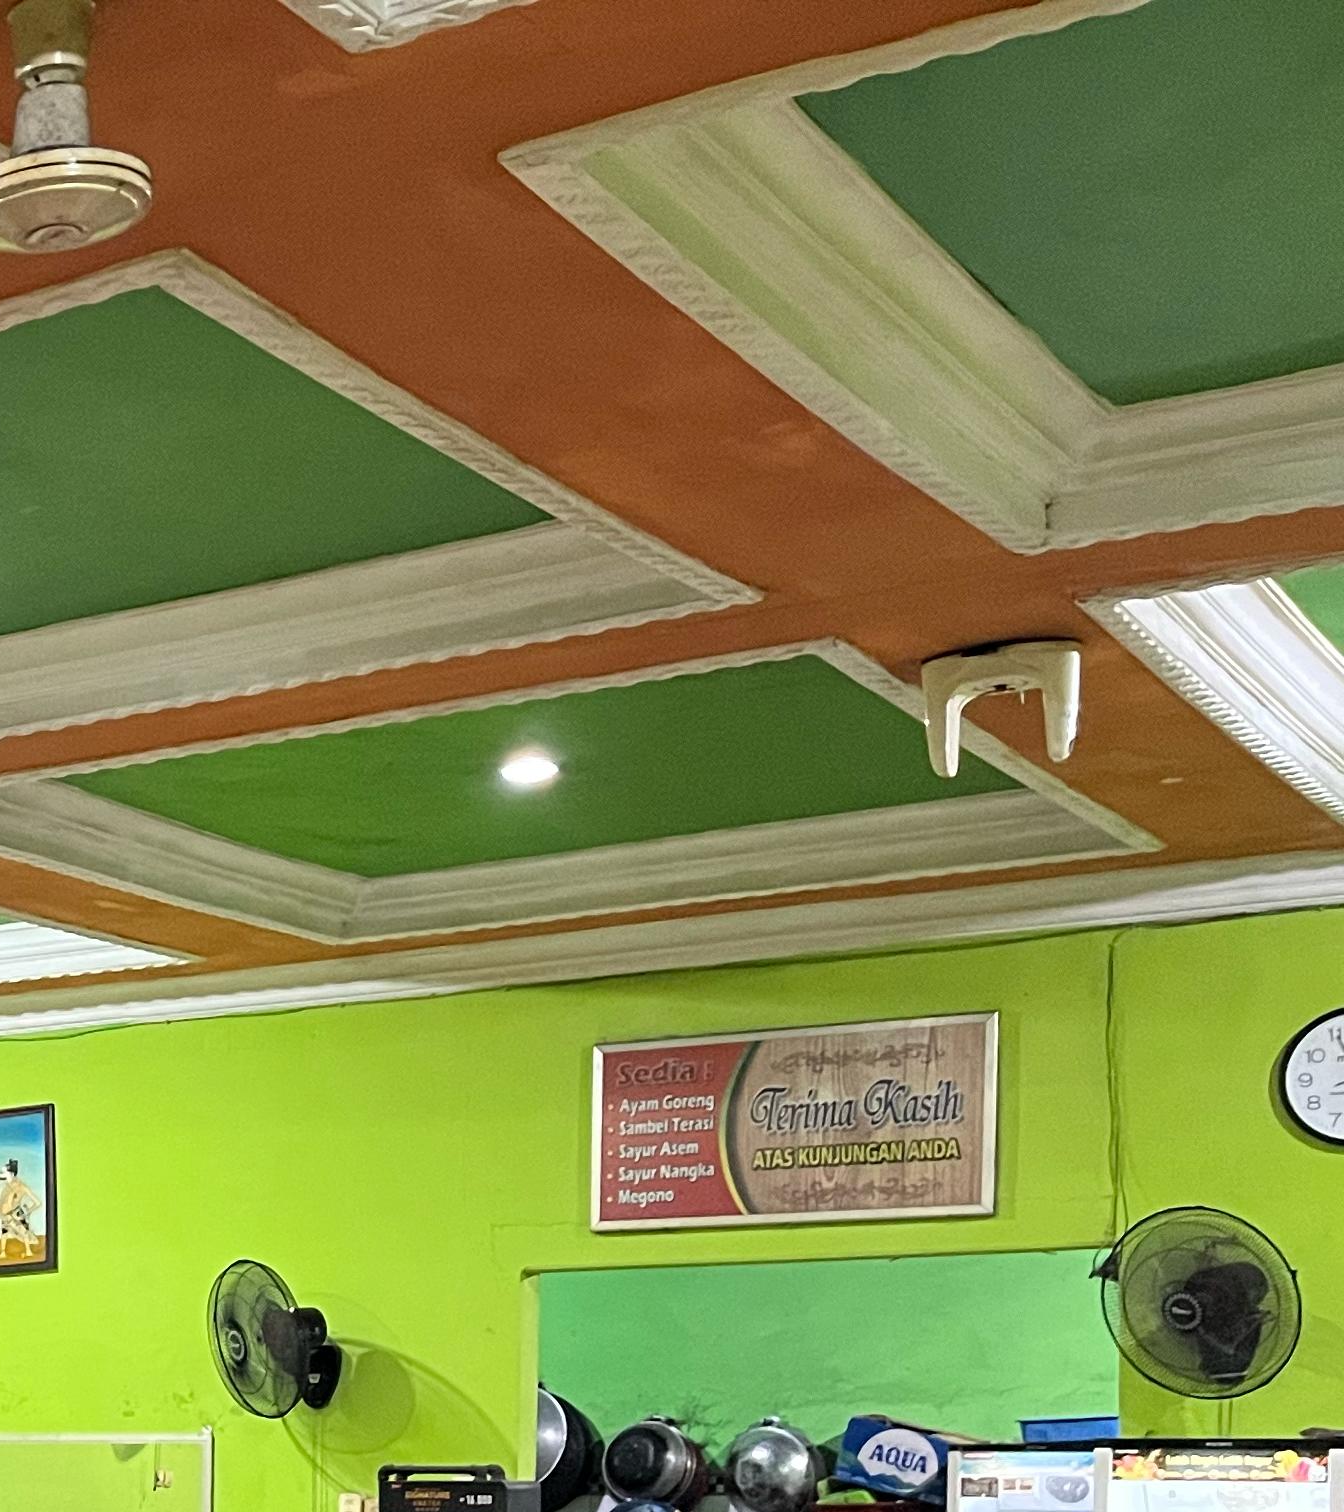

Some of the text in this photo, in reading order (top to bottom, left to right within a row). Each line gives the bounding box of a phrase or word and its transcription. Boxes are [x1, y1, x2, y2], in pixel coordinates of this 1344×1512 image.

[1306, 1048, 1326, 1063] 10
[1298, 1073, 1313, 1087] 9
[619, 1094, 715, 1117] Ayam Goreng
[750, 1079, 961, 1132] Terima Kasih
[1307, 1095, 1321, 1110] 8
[619, 1115, 714, 1136] Sambel Terasi
[1328, 1113, 1342, 1128] 7
[619, 1141, 699, 1162] Sayur Asem
[752, 1138, 960, 1170] ATAS KUNJUNGAN ANDA
[618, 1163, 715, 1185] Sayur Nangka
[618, 1189, 674, 1208] Megono
[869, 1444, 928, 1474] AQUA
